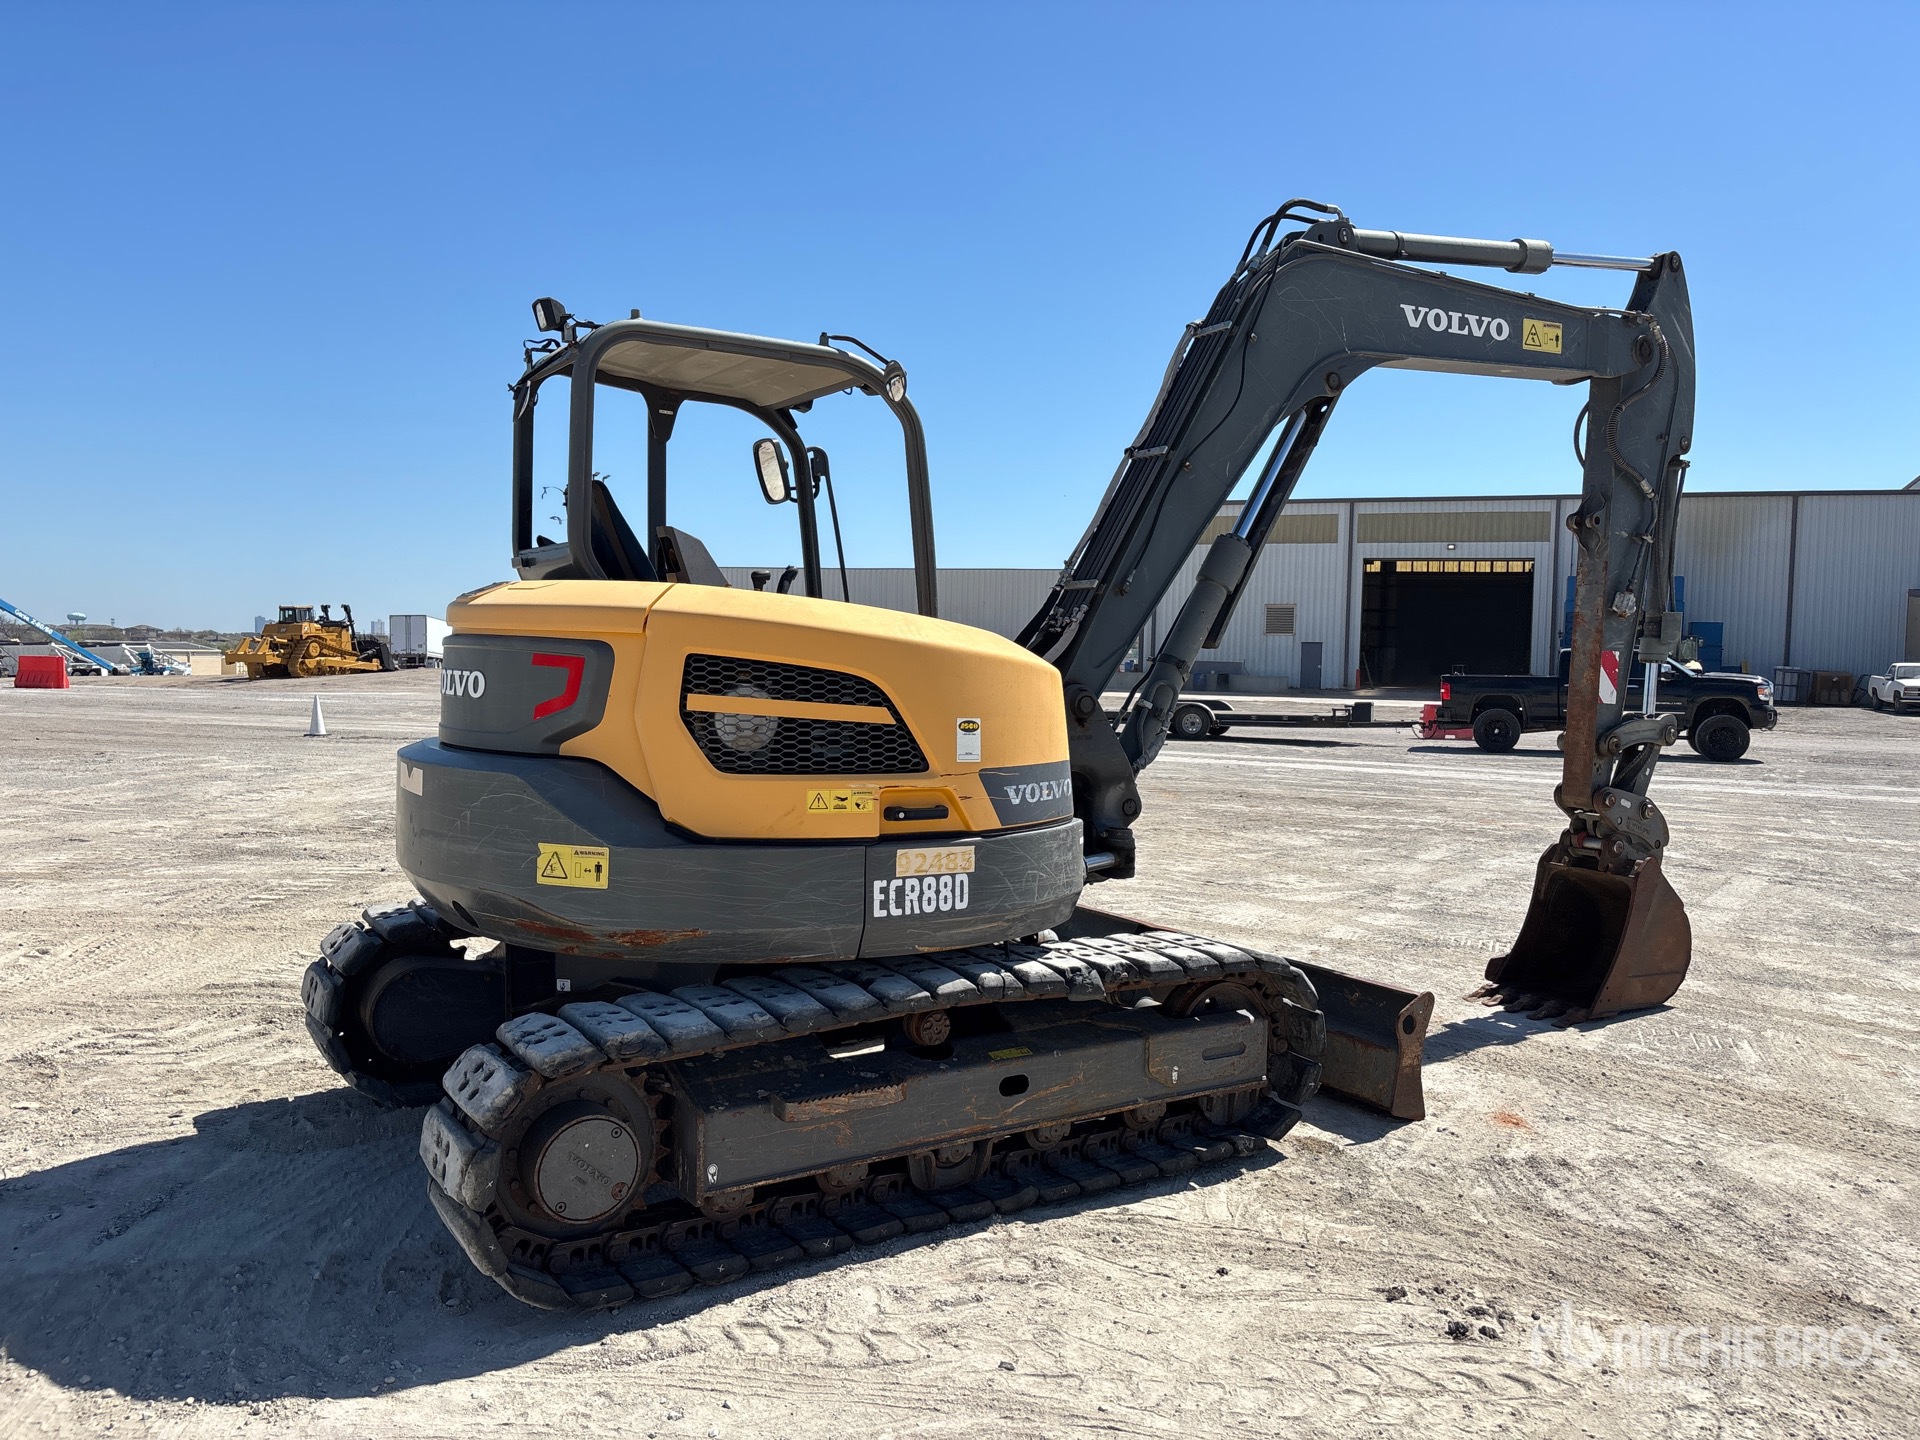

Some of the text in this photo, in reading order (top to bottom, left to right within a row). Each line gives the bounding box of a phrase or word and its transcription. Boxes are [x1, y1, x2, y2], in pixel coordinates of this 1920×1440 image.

[1400, 303, 1510, 341] VOLVO
[1003, 778, 1072, 805] VOLVO
[873, 873, 969, 918] ECR88D
[568, 1151, 611, 1186] VOLVO
